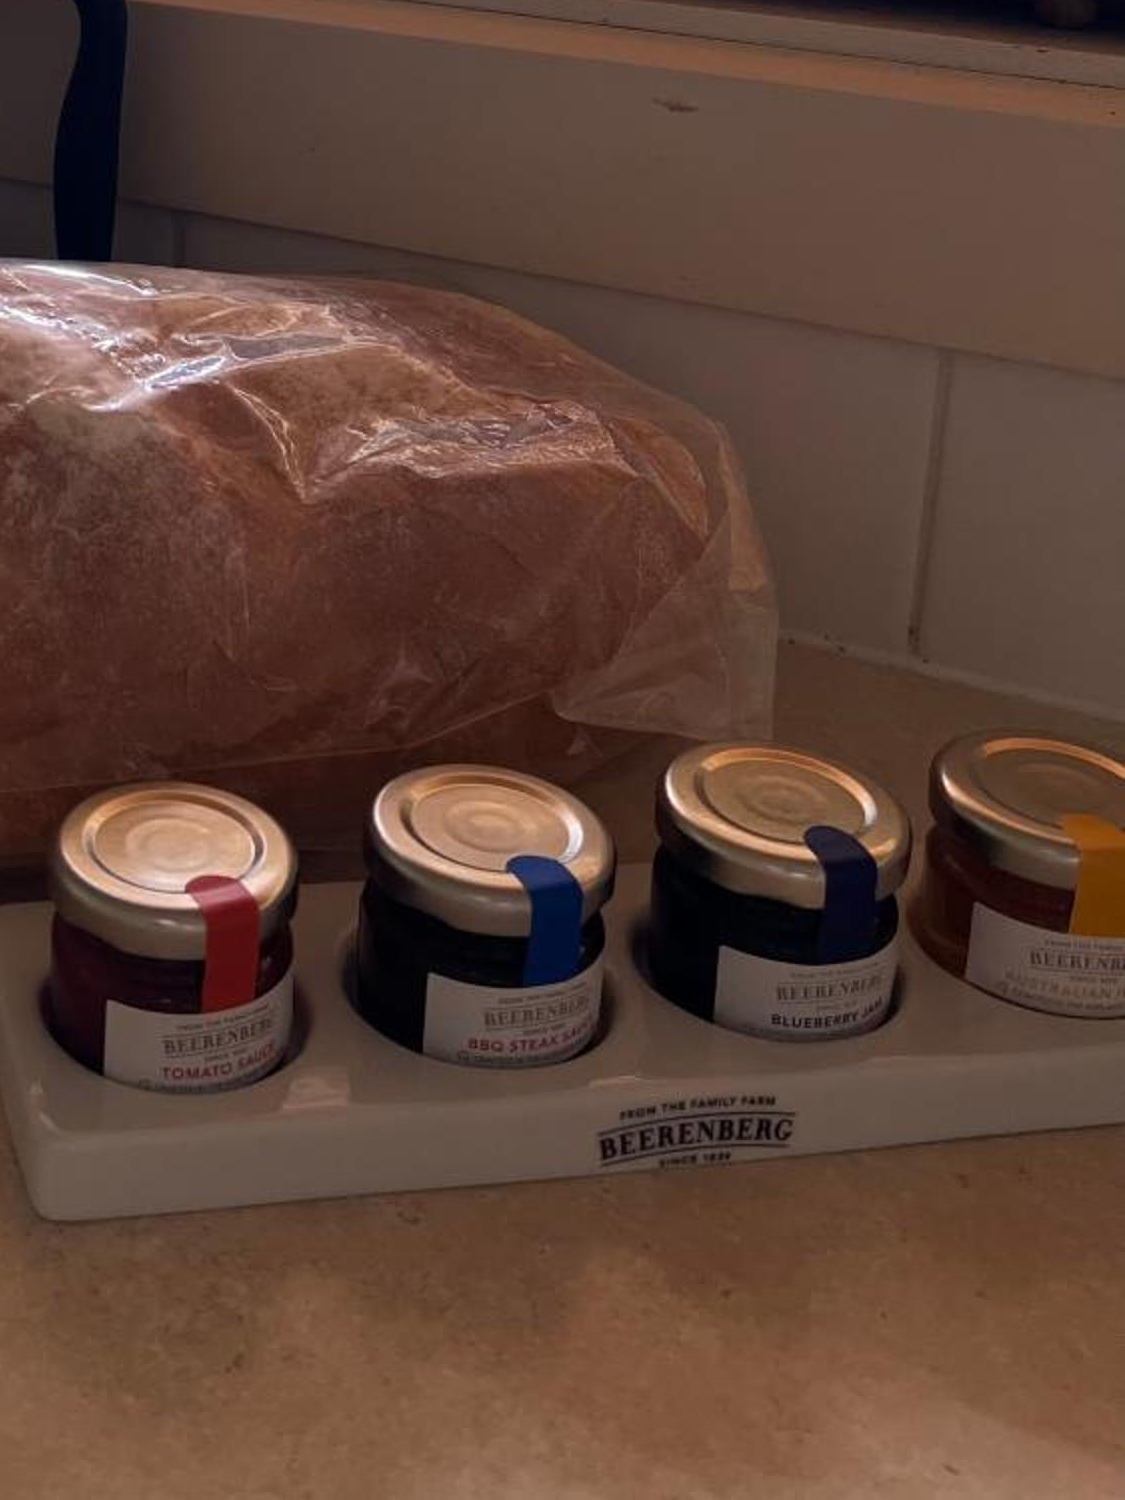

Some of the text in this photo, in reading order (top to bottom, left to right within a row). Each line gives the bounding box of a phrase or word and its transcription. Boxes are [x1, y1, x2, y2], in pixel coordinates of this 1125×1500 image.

[771, 1012, 859, 1029] BLUEBERRY
[468, 1037, 504, 1052] BBQ
[509, 1036, 557, 1053] STEAK
[163, 1063, 233, 1080] TOMATO
[620, 1096, 776, 1119] FROM THE FAMILY FARM
[599, 1117, 794, 1161] BEERENBERG
